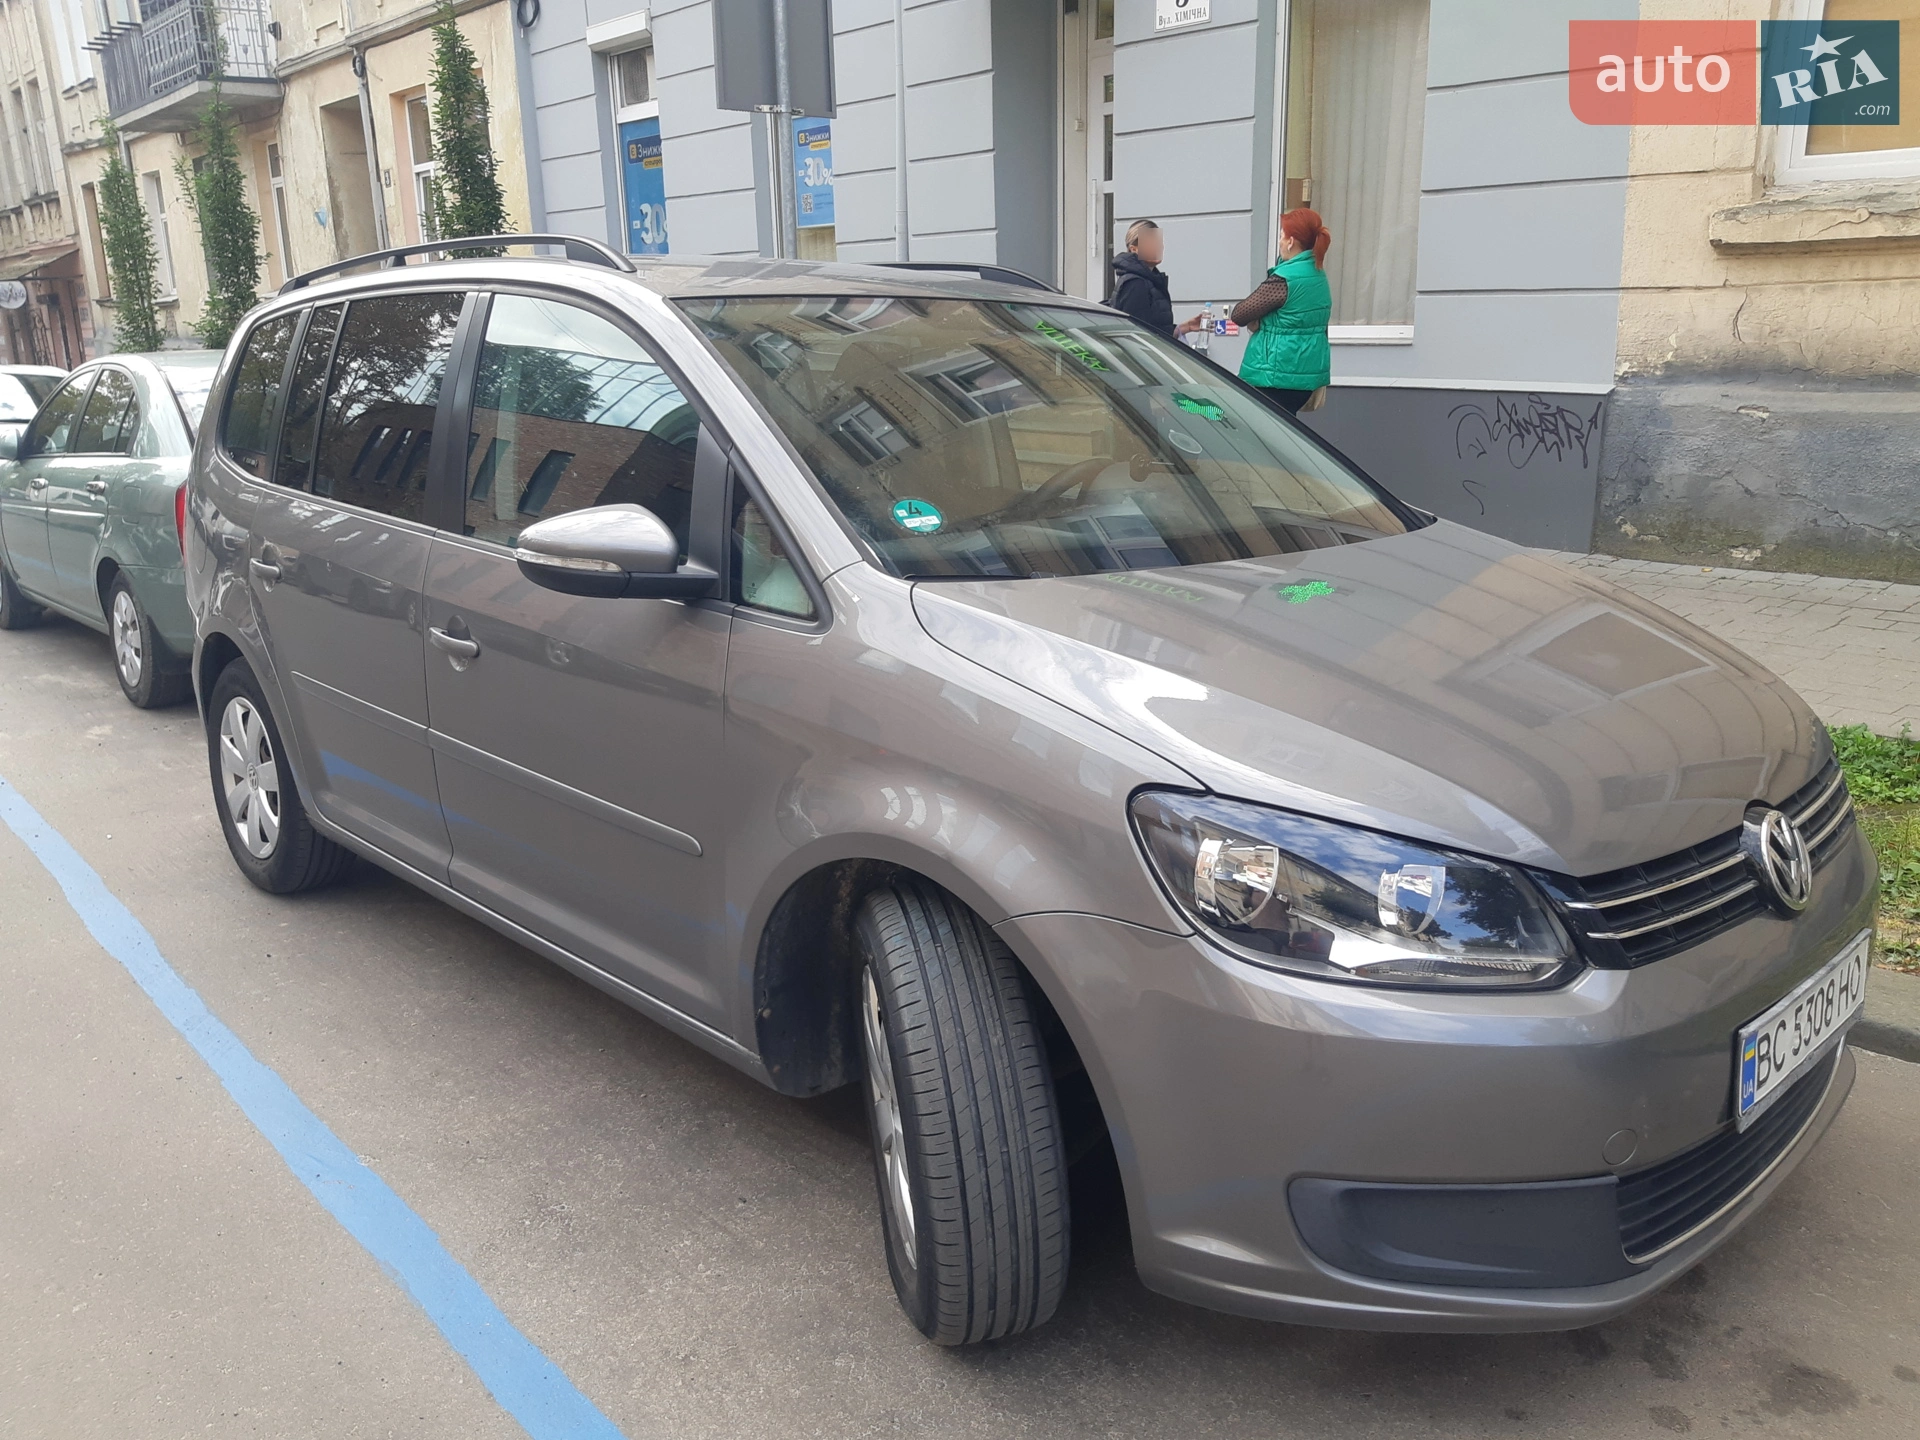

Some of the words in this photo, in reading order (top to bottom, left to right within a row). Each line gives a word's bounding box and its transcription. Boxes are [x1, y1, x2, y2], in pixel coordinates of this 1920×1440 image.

[1158, 15, 1173, 29] Вул.
[1174, 7, 1207, 23] ХІМІЧНА
[805, 131, 830, 143] Знижки
[799, 157, 834, 188] -30%
[908, 501, 923, 516] 4
[1756, 1019, 1787, 1092] BC
[1791, 978, 1835, 1057] 5308
[1836, 954, 1861, 1018] HO
[1743, 1078, 1754, 1099] UA
